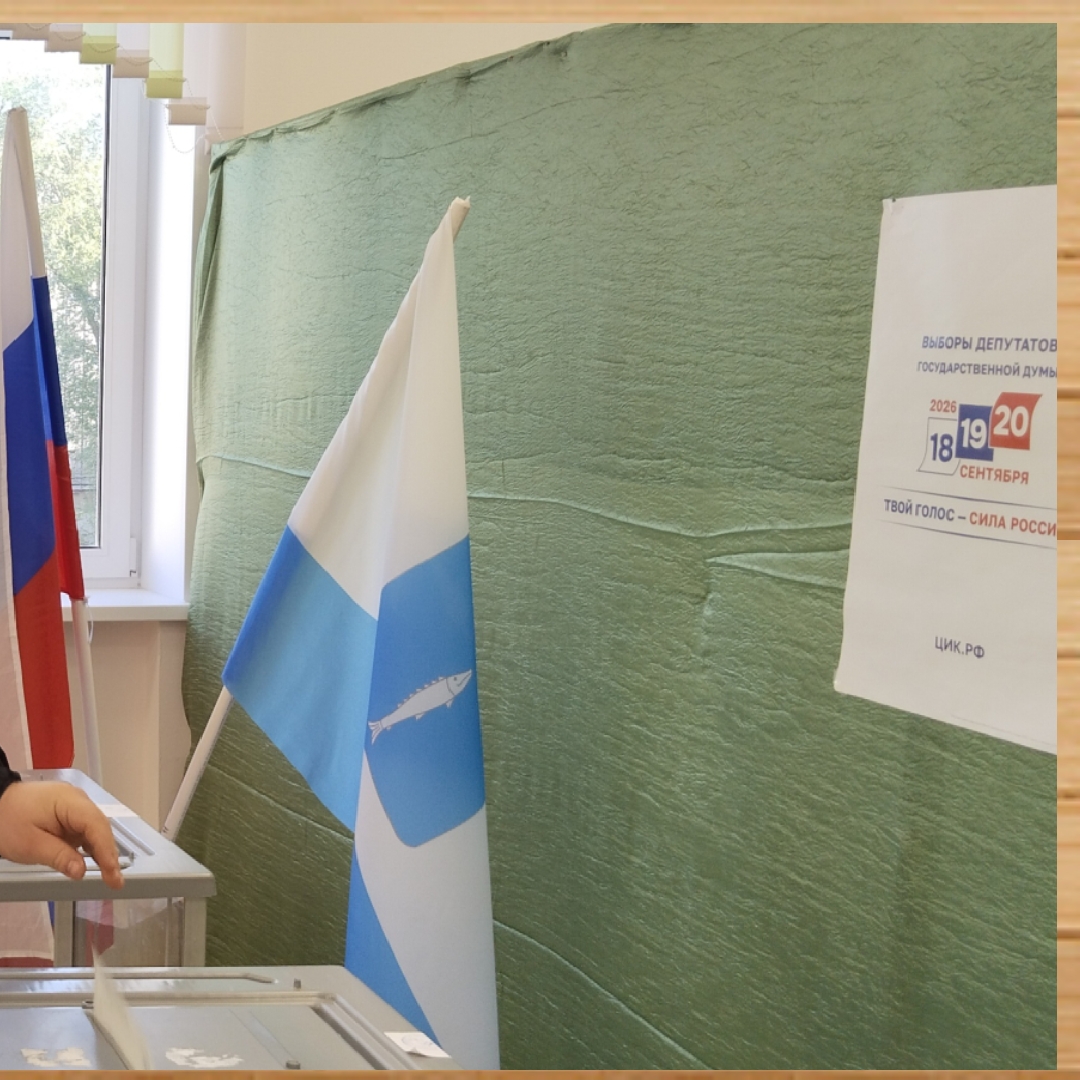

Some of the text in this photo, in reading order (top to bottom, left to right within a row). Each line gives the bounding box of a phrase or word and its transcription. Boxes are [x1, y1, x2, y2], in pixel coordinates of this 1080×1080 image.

[921, 335, 1058, 353] ВЫБОРЫ ДЕПУТАТОВ
[917, 360, 1020, 377] ГОСУДАРСТВЕННОЙ
[929, 398, 958, 414] 2026
[930, 404, 1030, 463] 18 19 20
[959, 464, 1030, 486] СЕНТЯБРЯ
[883, 498, 913, 516] ТВОЙ
[915, 503, 955, 522] ГОЛОС
[969, 510, 1006, 530] СИЛА
[934, 636, 985, 659] ЦИК.РФ
